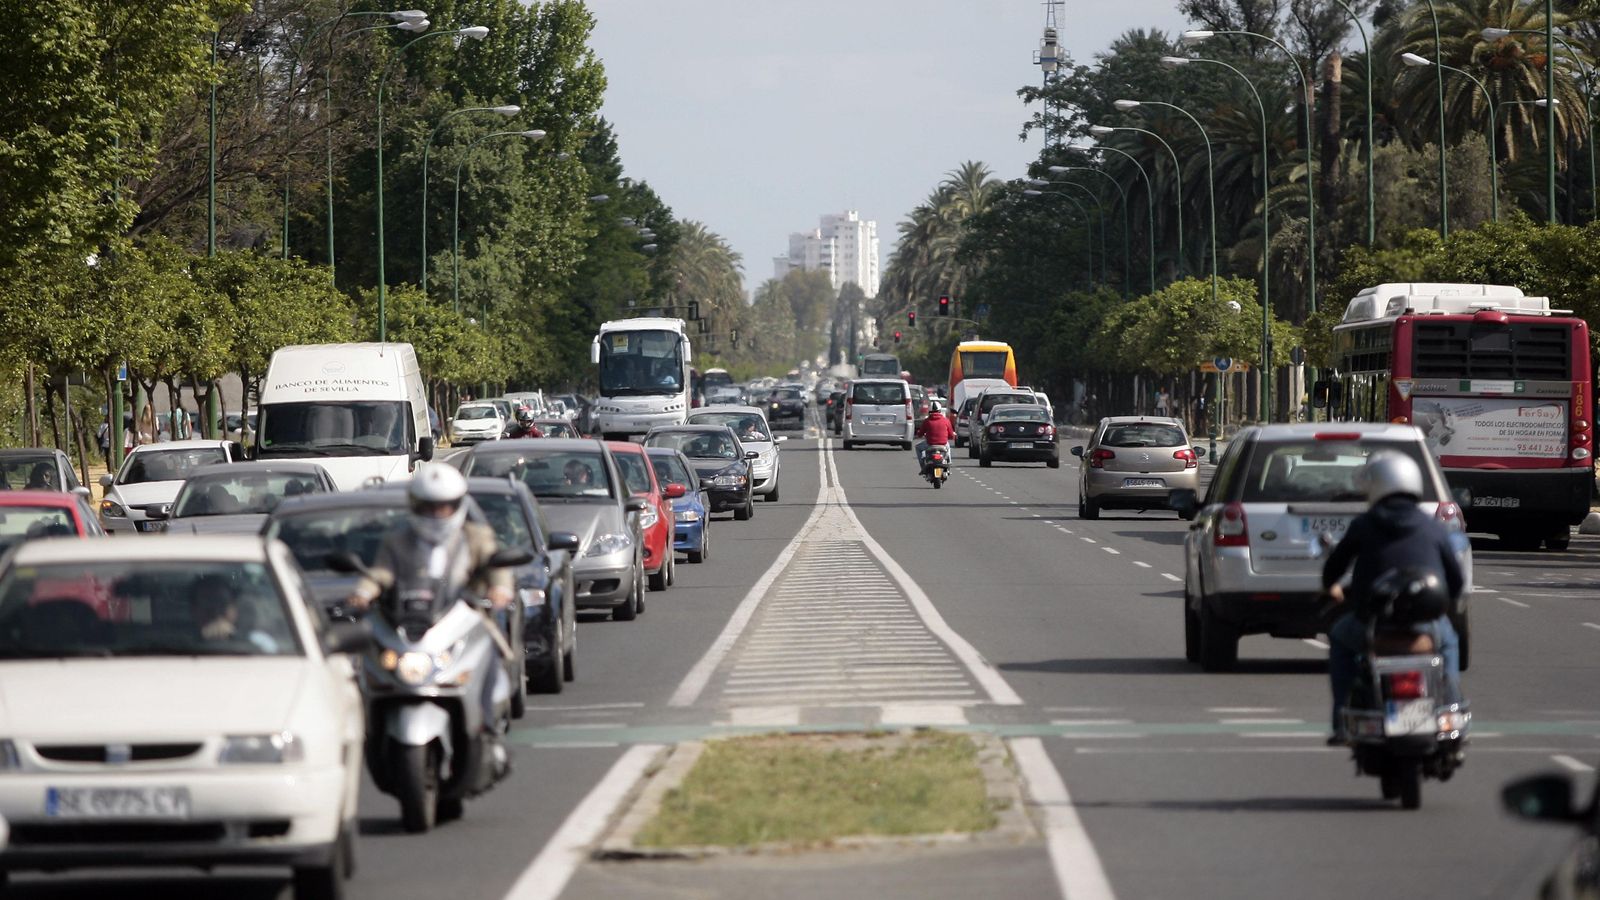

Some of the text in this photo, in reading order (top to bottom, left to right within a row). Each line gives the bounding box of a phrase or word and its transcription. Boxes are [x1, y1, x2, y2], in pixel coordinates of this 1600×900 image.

[275, 380, 312, 390] BANCO
[330, 379, 390, 387] ALIMENTOS
[1575, 383, 1584, 417] 186
[1506, 421, 1565, 429] ELECTRODOMÉSTICOS
[1312, 518, 1346, 531] 4595
